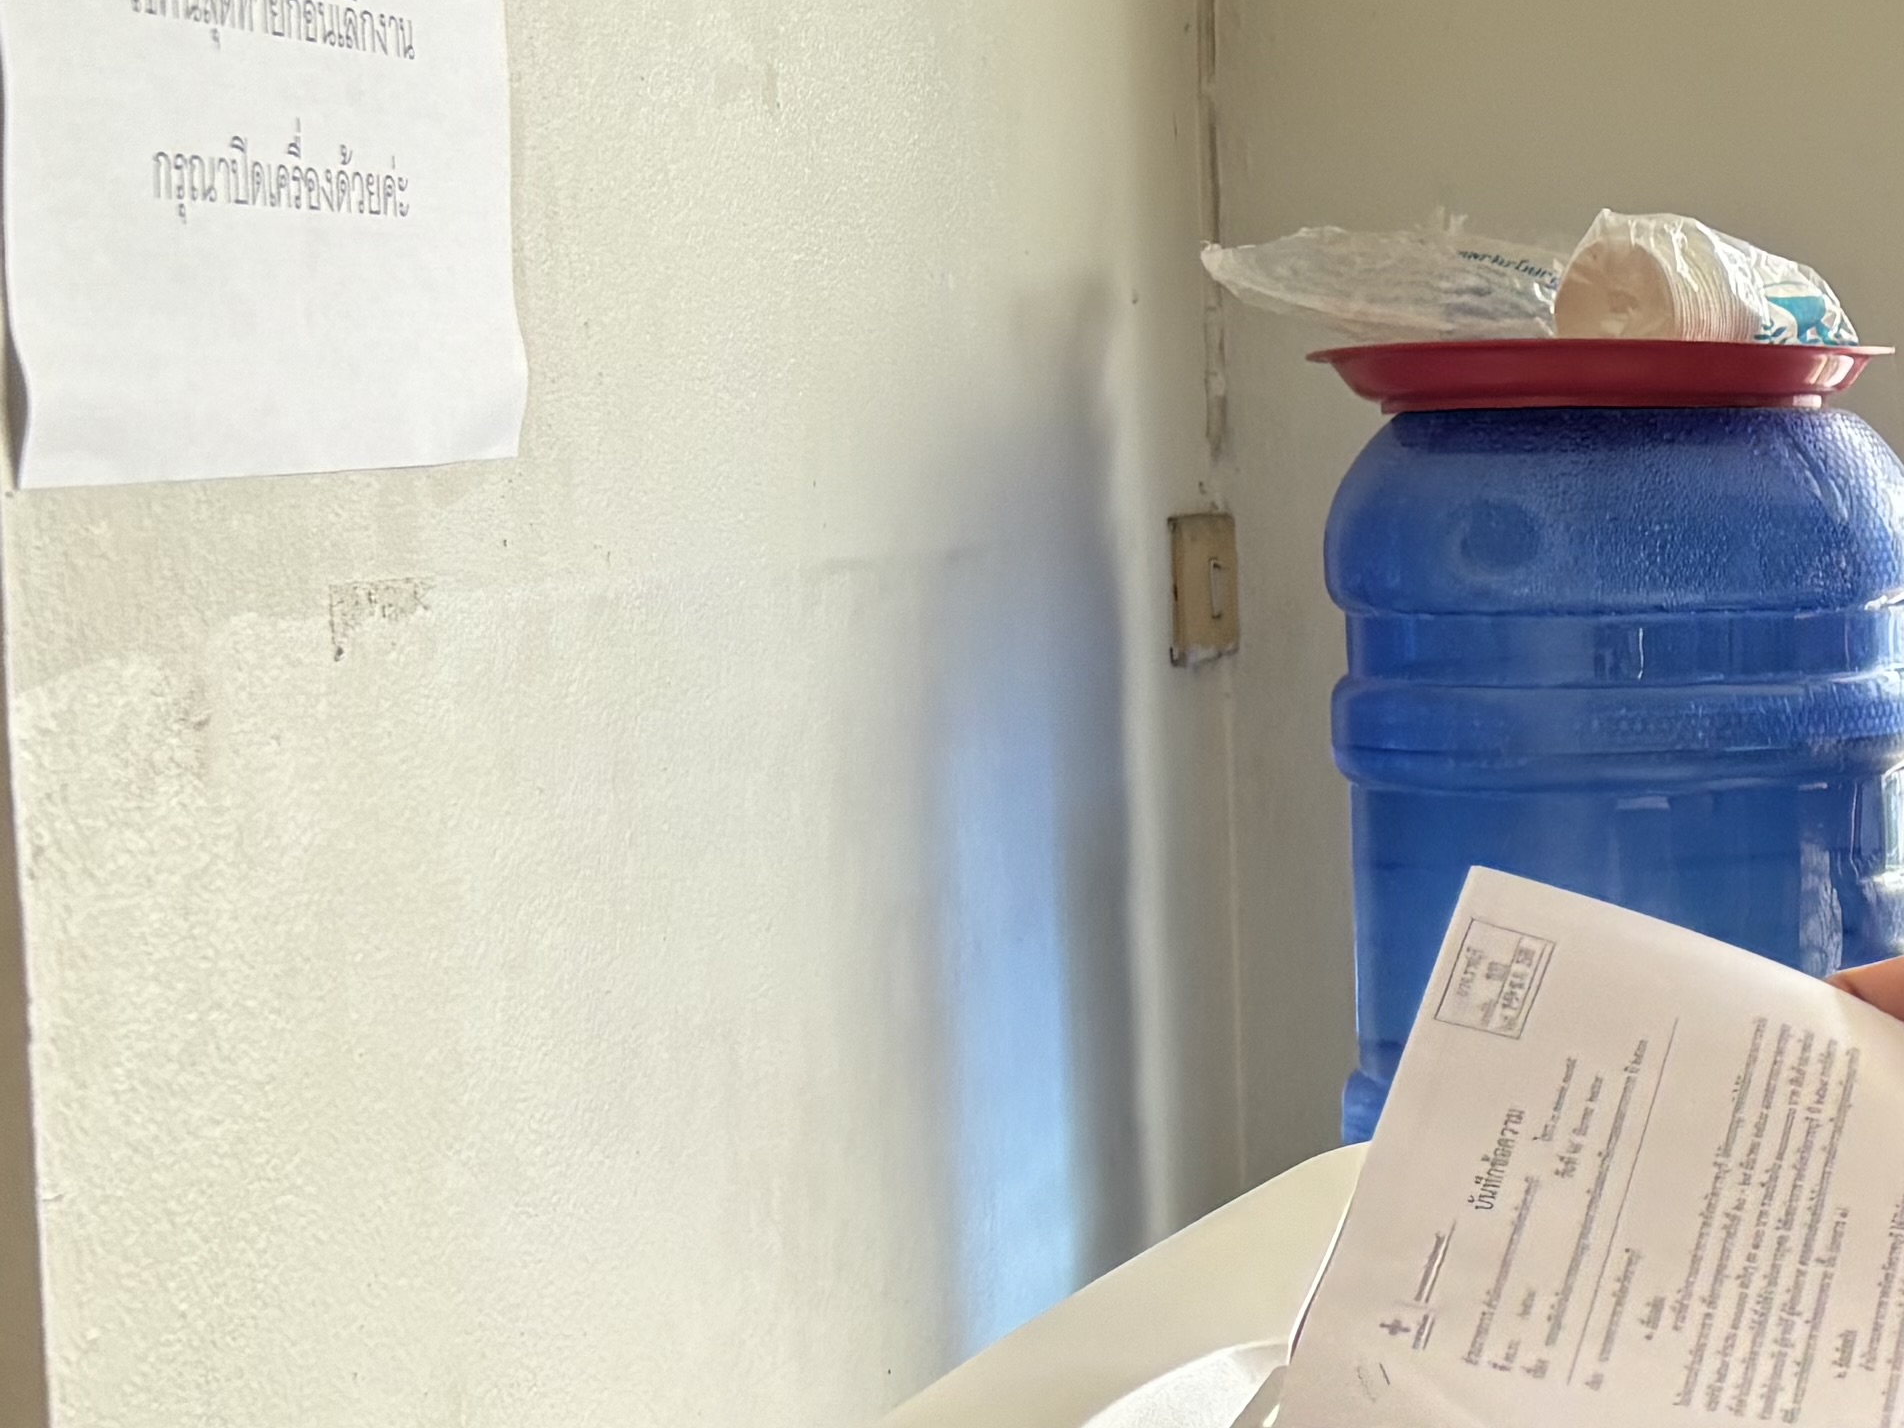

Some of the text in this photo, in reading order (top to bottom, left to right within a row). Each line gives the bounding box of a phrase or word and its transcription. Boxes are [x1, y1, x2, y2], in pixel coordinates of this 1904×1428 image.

[152, 117, 410, 224] กรุณาปิดเครื่องด้วยค่ะ
[1467, 1108, 1526, 1211] บันทึกข้อความ
